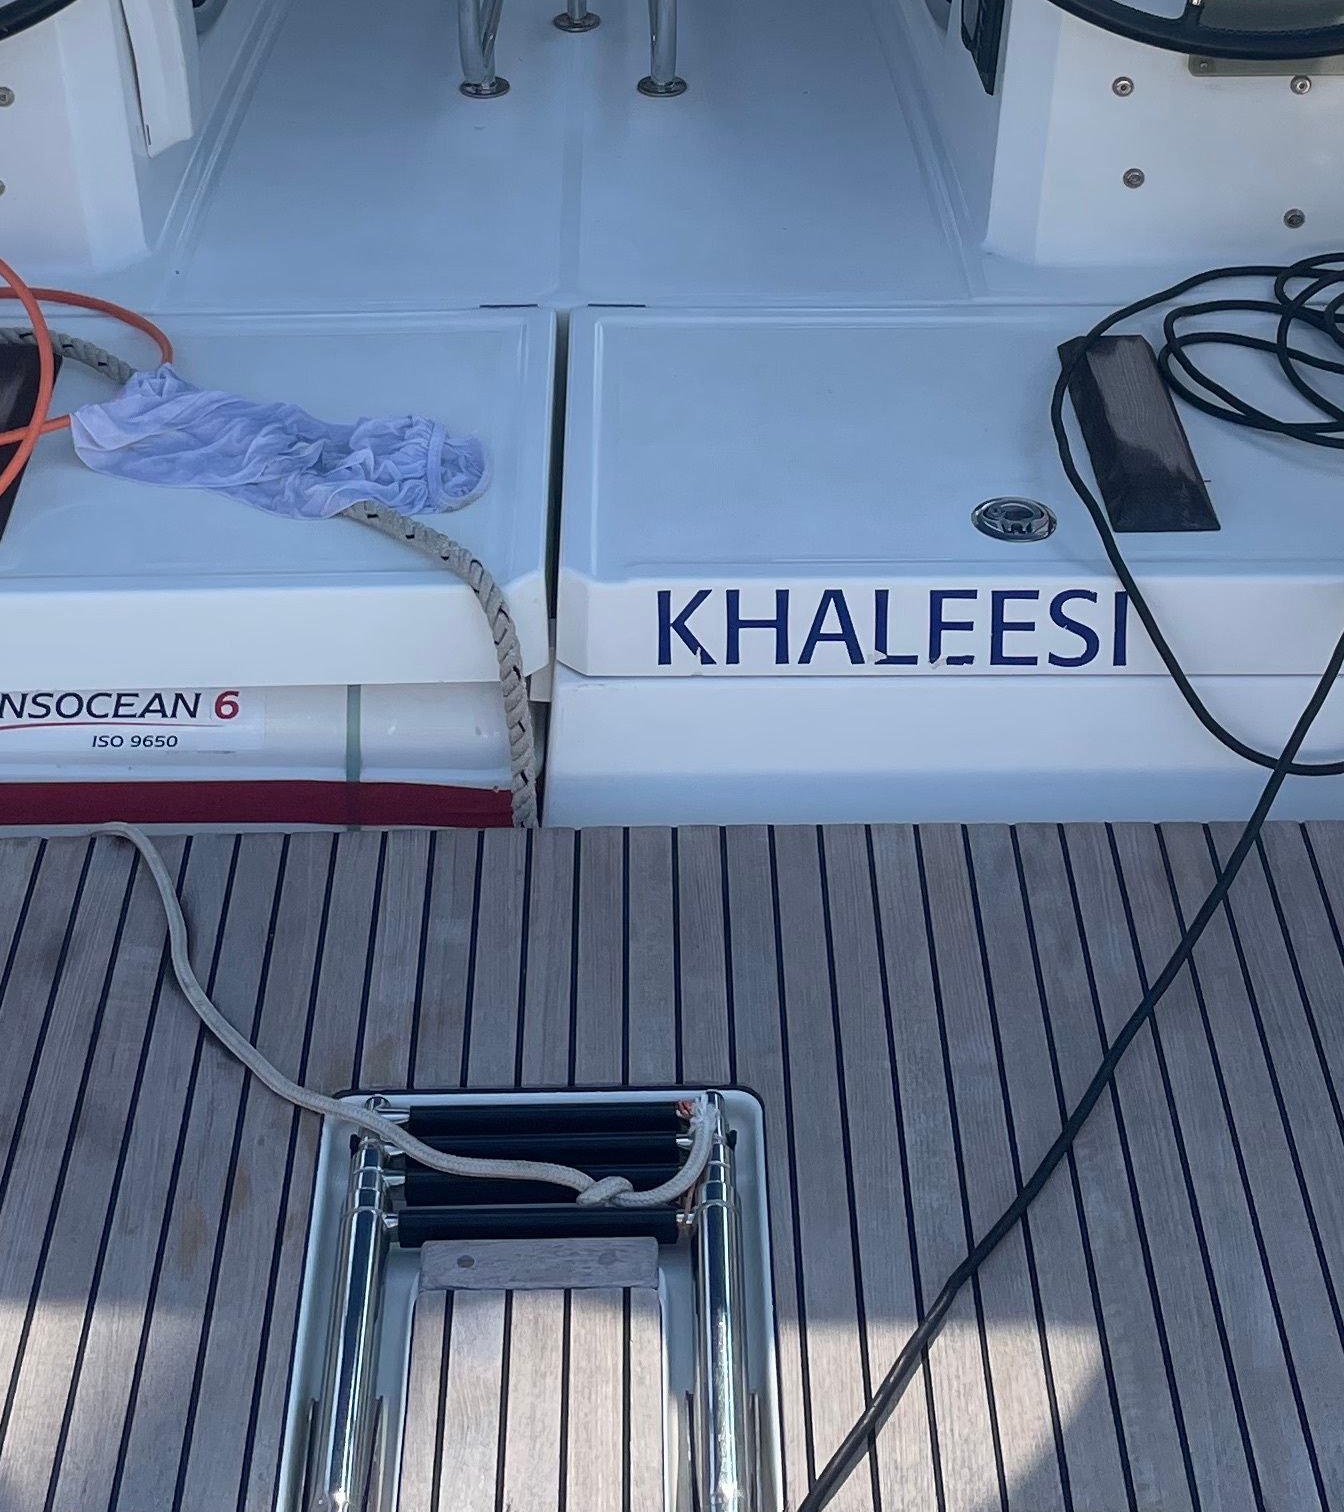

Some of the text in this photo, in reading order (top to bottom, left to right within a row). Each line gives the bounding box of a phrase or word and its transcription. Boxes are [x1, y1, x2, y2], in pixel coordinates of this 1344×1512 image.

[657, 589, 1129, 668] KHALEESI
[214, 690, 240, 721] 6
[92, 734, 179, 749] ISO 9650
